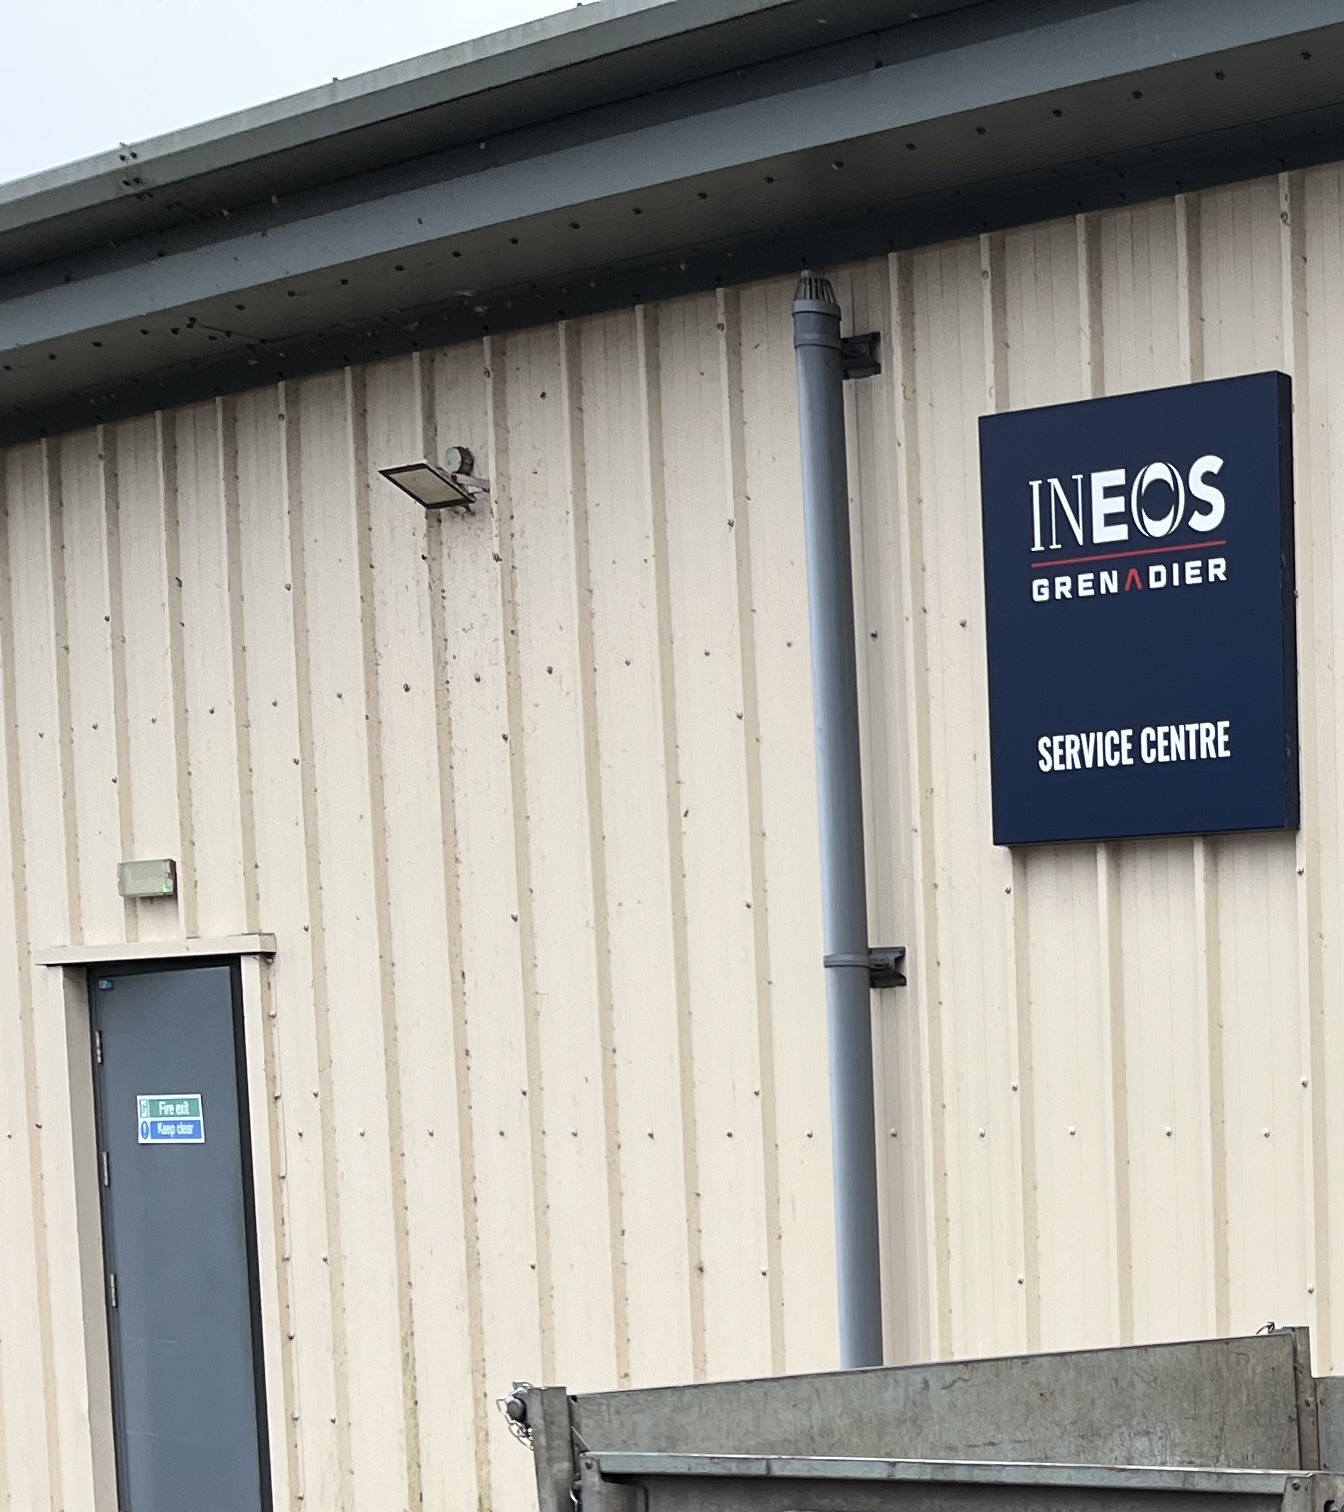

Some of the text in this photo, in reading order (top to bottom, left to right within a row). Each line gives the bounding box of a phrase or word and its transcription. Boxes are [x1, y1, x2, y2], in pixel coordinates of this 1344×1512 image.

[1029, 454, 1227, 552] INEOS
[1032, 557, 1227, 602] GRENADIER
[1037, 720, 1231, 773] SERVICE CENTRE
[157, 1121, 194, 1138] Keep clear
[158, 1101, 190, 1115] Fire exit
